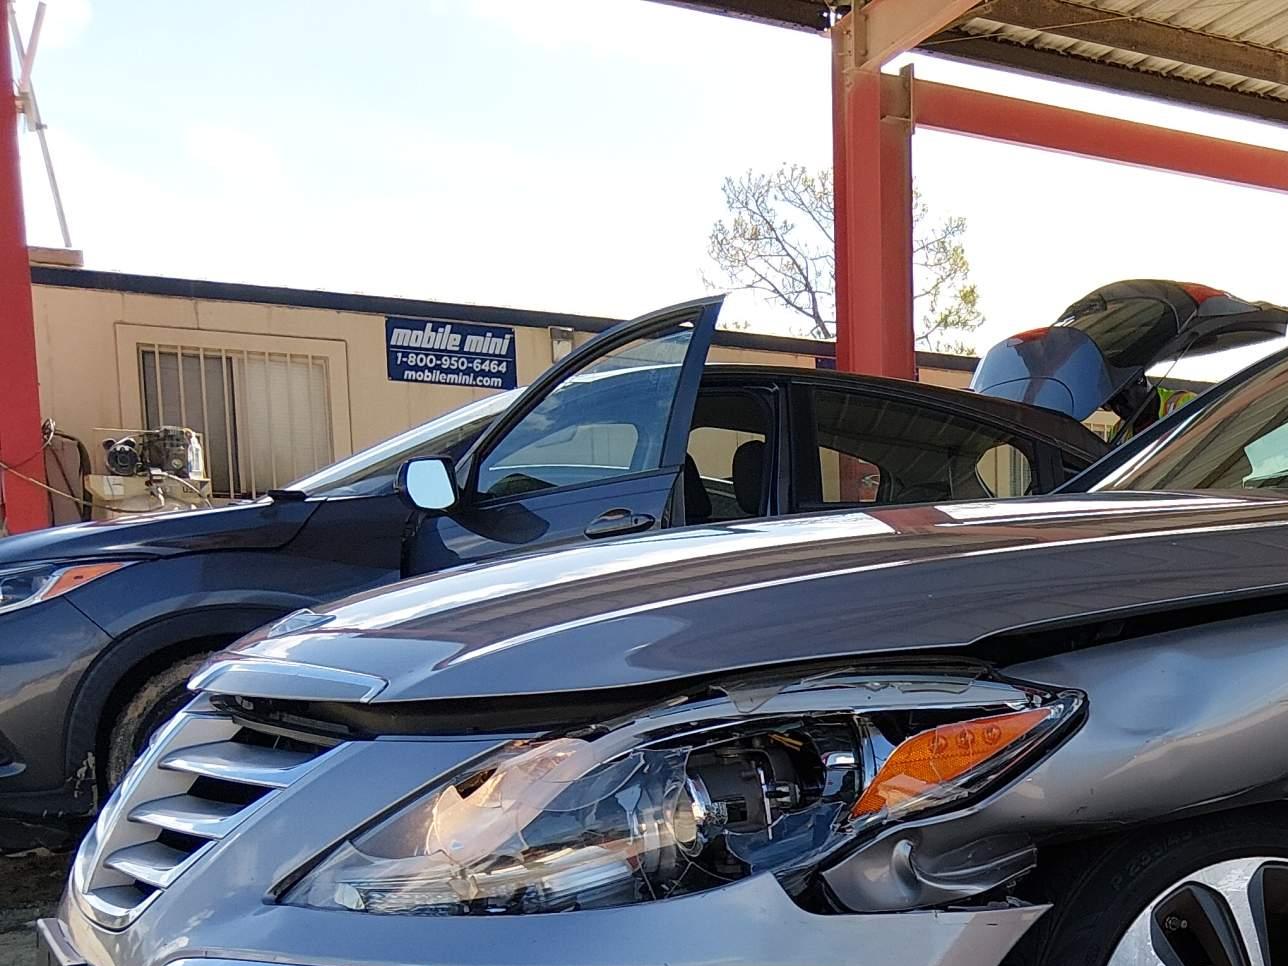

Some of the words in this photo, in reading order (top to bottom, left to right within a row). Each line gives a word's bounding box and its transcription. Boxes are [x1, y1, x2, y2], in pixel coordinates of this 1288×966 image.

[390, 322, 462, 351] mobile
[463, 332, 513, 355] mini
[396, 352, 507, 374] 1-800-950-6464
[403, 369, 502, 387] mobilemini.com
